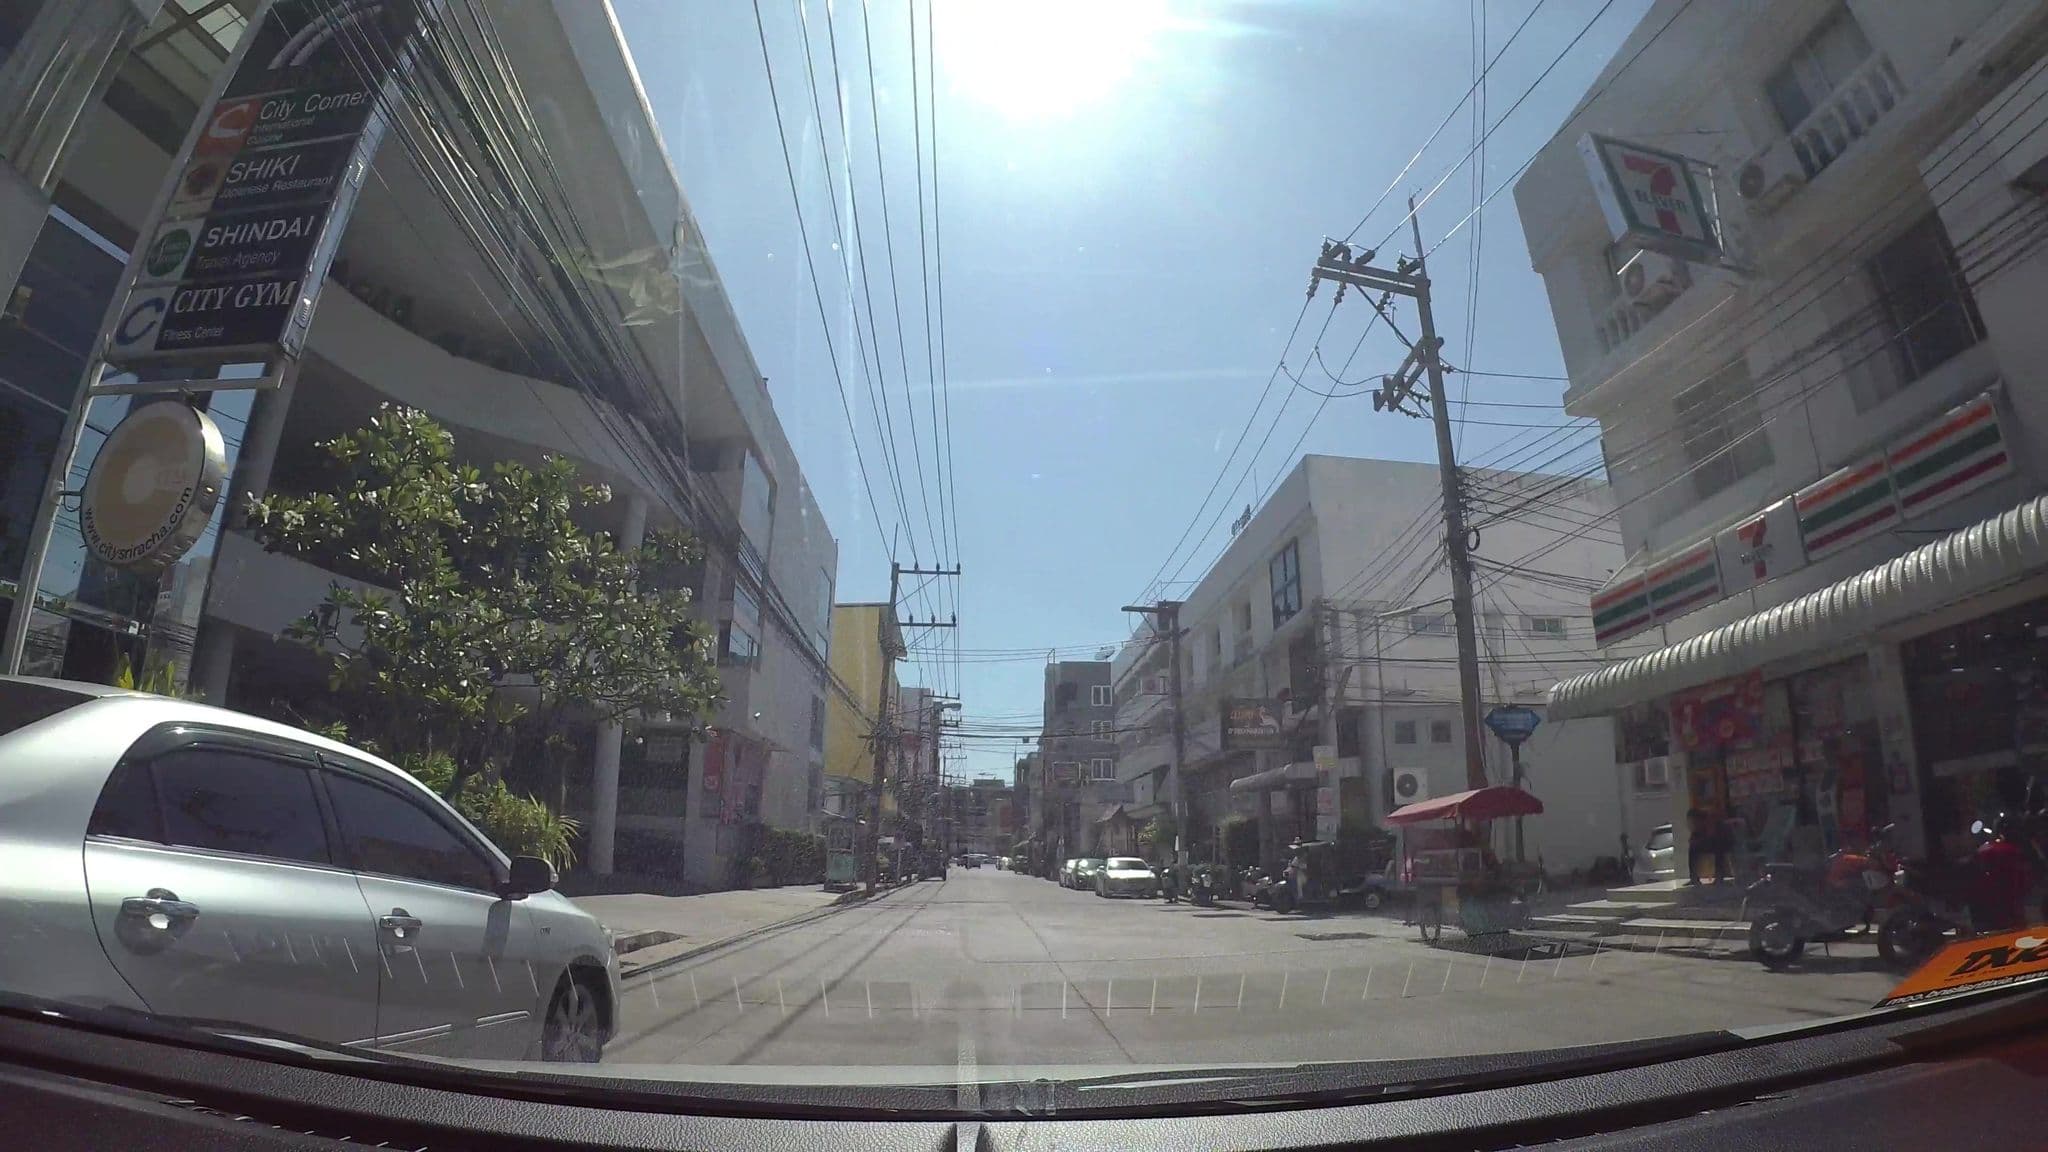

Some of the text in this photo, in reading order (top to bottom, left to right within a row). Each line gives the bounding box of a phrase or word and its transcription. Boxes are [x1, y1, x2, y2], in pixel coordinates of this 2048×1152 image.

[260, 91, 369, 121] City Corner
[226, 154, 301, 184] SHIKI
[272, 175, 334, 192] Restaurant
[204, 215, 315, 248] SHINDAI
[233, 249, 280, 268] Agency
[174, 280, 298, 314] CITY GYM
[194, 325, 225, 339] Center
[84, 487, 193, 561] www.citysriracha.com
